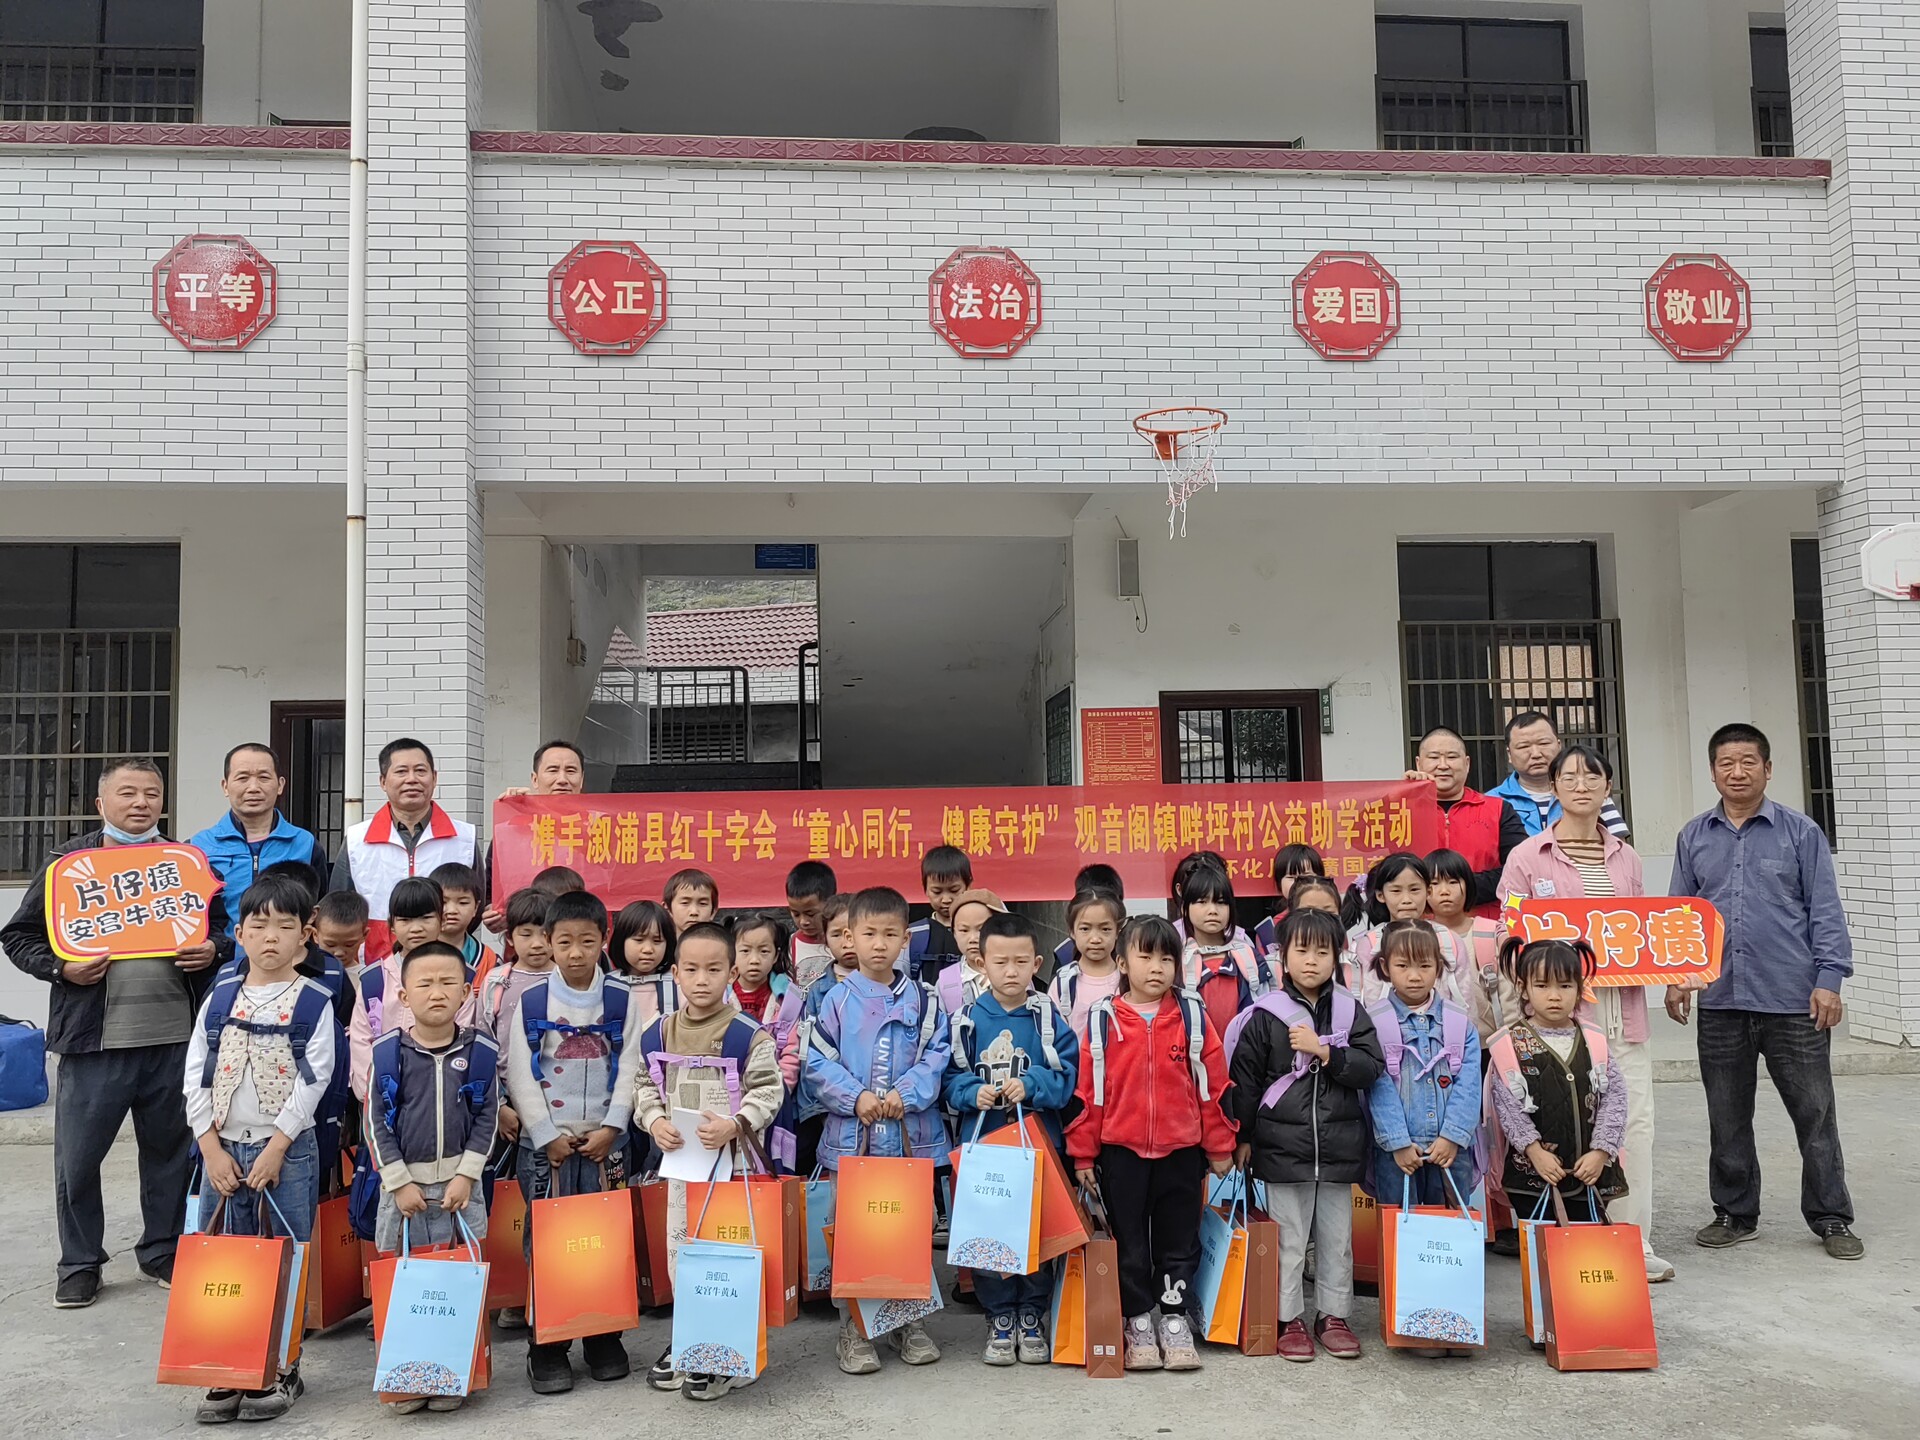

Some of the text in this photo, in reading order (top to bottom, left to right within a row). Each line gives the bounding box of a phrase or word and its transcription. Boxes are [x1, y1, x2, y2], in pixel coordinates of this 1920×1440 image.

[174, 272, 256, 312] 平等
[569, 278, 647, 315] 公正
[949, 282, 1024, 320] 法治
[1312, 286, 1382, 324] 爱国
[1663, 288, 1734, 325] 敬业
[75, 861, 181, 911] 片仔癀
[67, 891, 206, 942] 安宫牛黄丸
[875, 1036, 891, 1135] UNIVEE
[1417, 1252, 1463, 1267] 安宫牛黄丸
[409, 1304, 456, 1317] 安宫牛黄丸
[695, 1285, 738, 1298] 安宫牛黄丸
